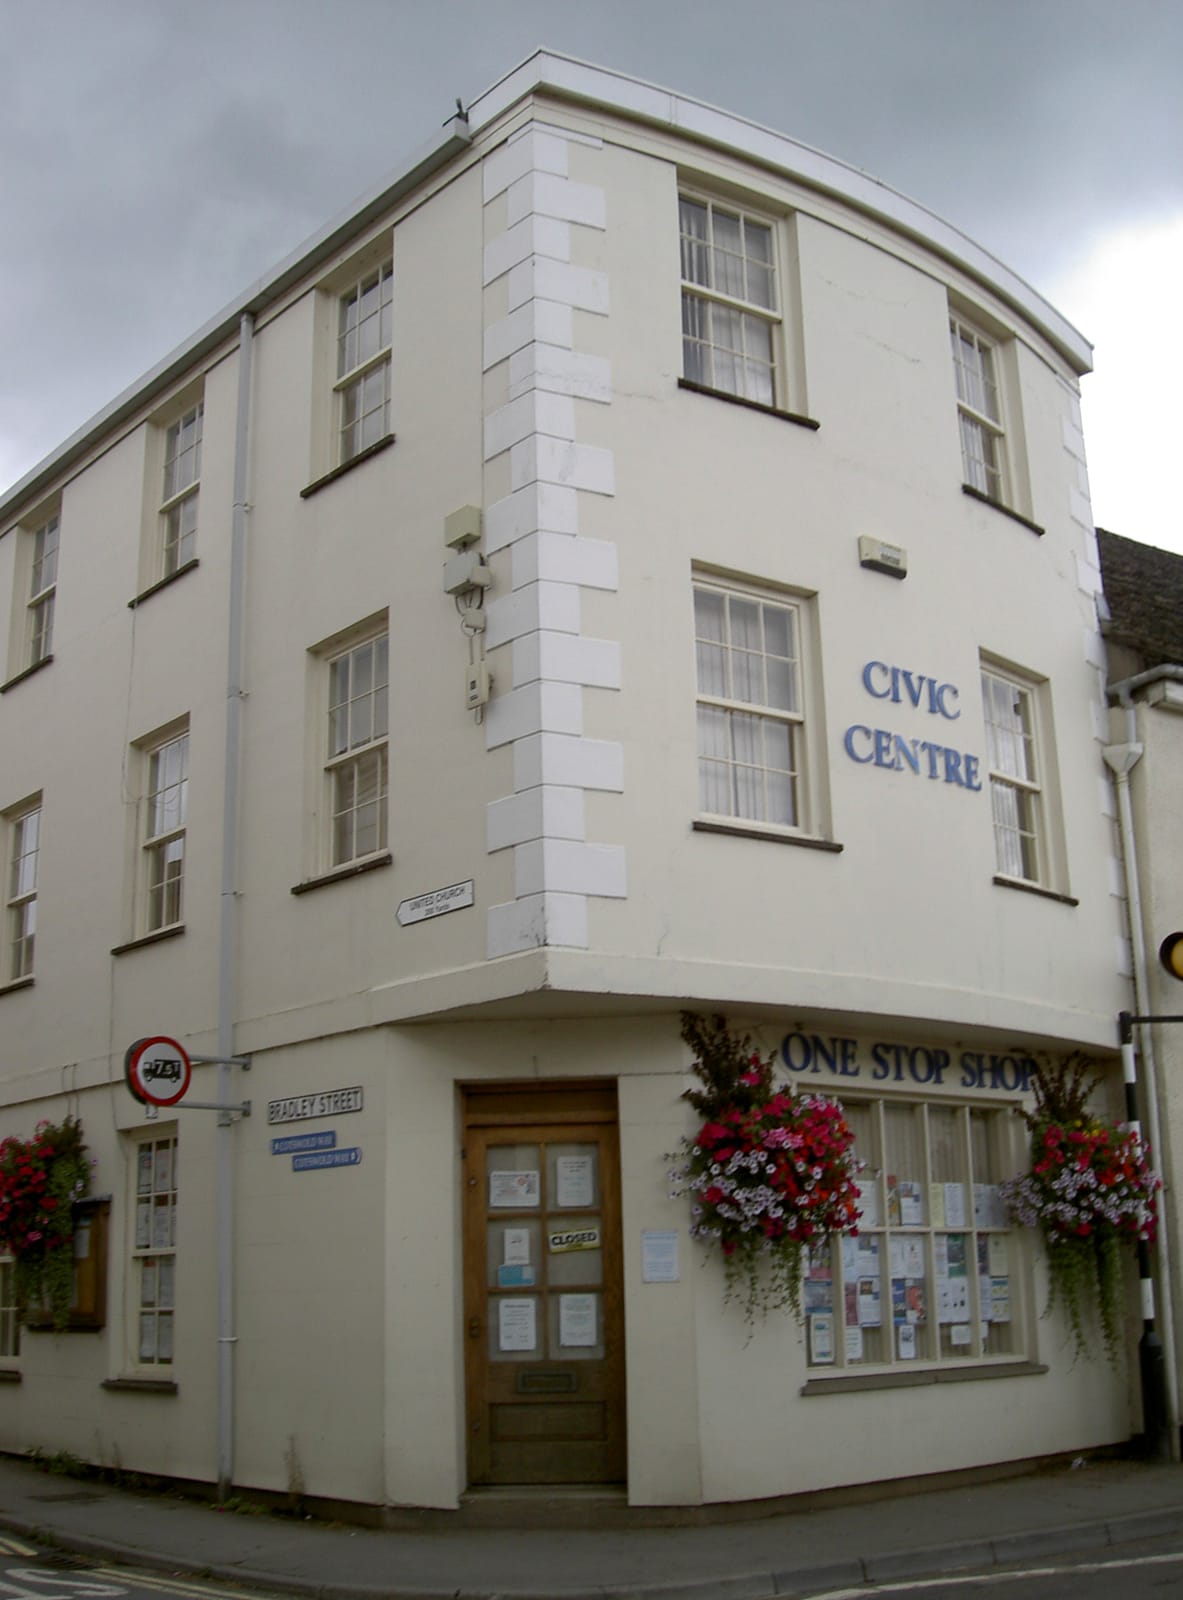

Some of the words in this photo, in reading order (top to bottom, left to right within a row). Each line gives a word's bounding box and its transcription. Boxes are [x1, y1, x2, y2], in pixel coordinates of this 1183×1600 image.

[862, 661, 961, 720] CIVIC
[844, 724, 982, 792] CENTRE
[782, 1032, 860, 1077] ONE
[872, 1043, 951, 1084] STOP
[961, 1052, 1036, 1092] SHOP
[269, 1098, 316, 1121] BRADLEY
[320, 1090, 360, 1113] STREET
[551, 1231, 598, 1246] CLOSED
